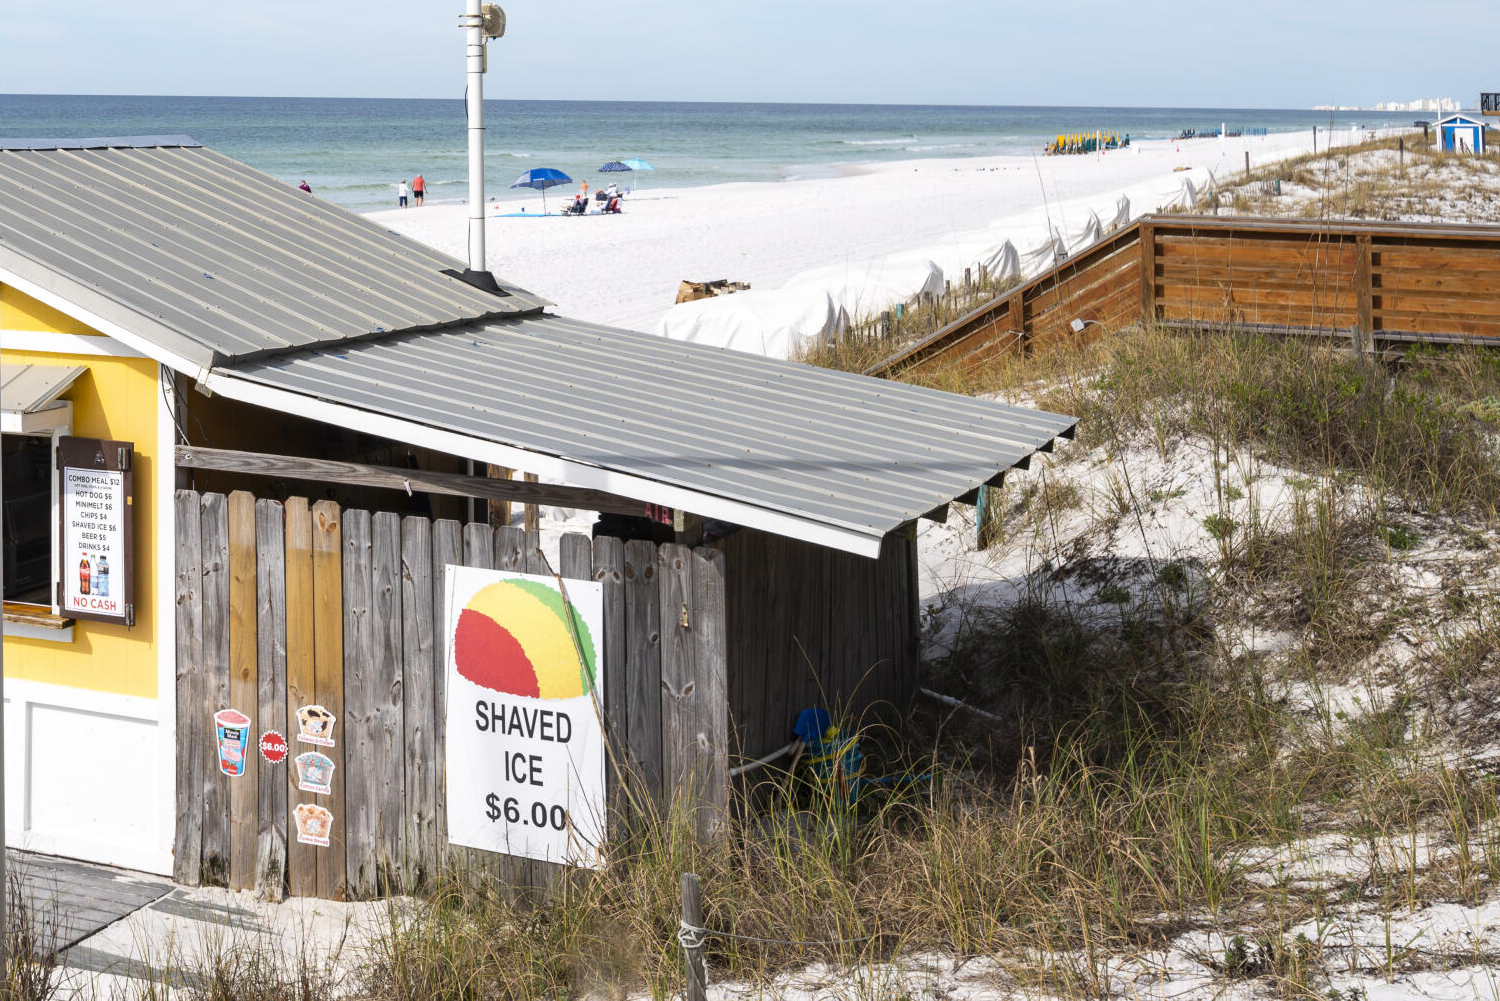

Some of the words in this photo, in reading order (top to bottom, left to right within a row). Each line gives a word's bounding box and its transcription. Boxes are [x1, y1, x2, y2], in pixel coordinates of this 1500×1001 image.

[68, 474, 91, 484] COMBO
[91, 476, 108, 486] MEAL
[110, 477, 120, 486] $12
[75, 490, 88, 499] HOT
[89, 491, 103, 500] DOG
[105, 492, 113, 501] $6
[75, 500, 104, 510] MINIMELT
[105, 502, 113, 511] $6
[80, 511, 99, 520] CHIPS
[99, 512, 107, 521] $4
[72, 520, 96, 530] SHAVED
[97, 522, 107, 531] ICE
[108, 523, 117, 532] $6
[82, 532, 98, 541] BEER
[98, 533, 107, 542] $5
[78, 542, 101, 551] DRINKS
[102, 543, 110, 552] $4
[73, 596, 89, 608] NO
[90, 597, 117, 611] CASH
[475, 700, 572, 744] SHAVED
[262, 741, 285, 753] $6.00
[504, 751, 544, 786] ICE
[485, 792, 567, 831] $6.00
